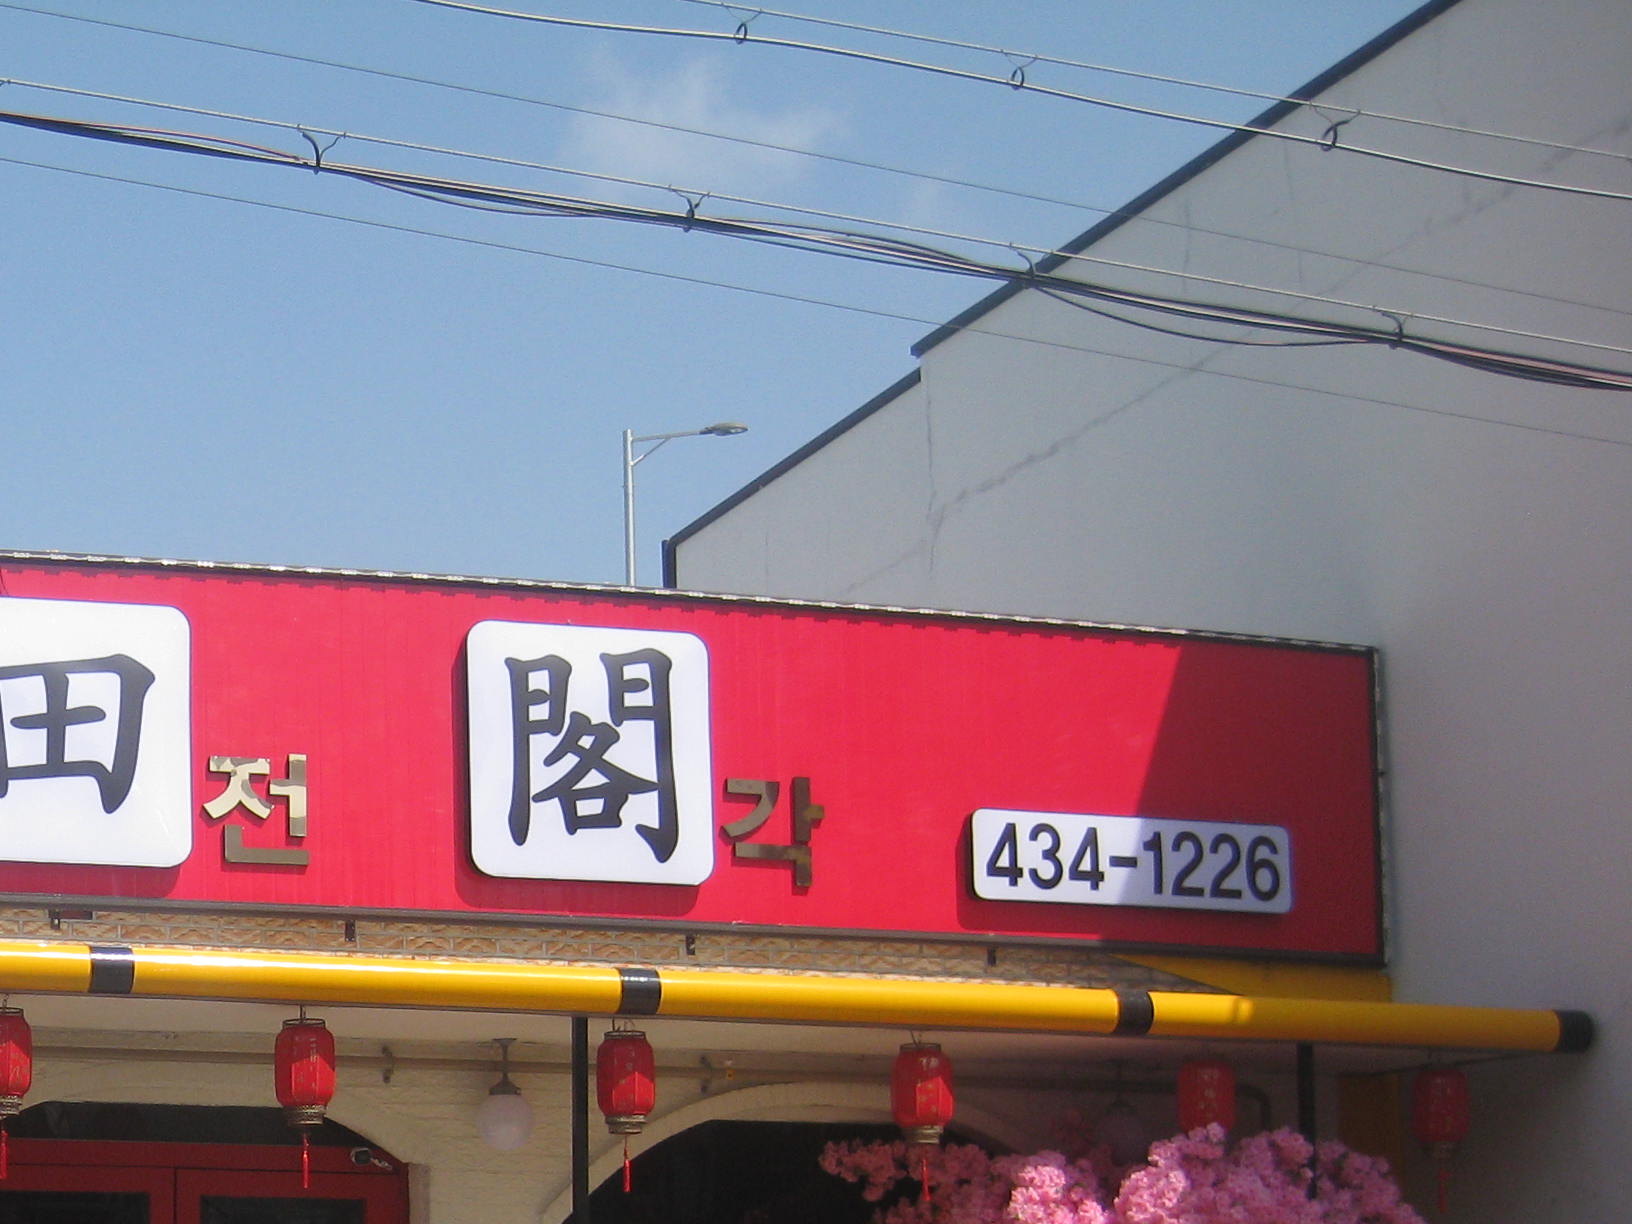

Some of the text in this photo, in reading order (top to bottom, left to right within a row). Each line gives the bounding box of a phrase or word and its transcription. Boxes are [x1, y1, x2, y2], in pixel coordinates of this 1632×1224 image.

[202, 753, 310, 866] 전
[503, 647, 679, 864] 閣
[721, 776, 825, 887] 각
[986, 822, 1280, 902] 434-1226
